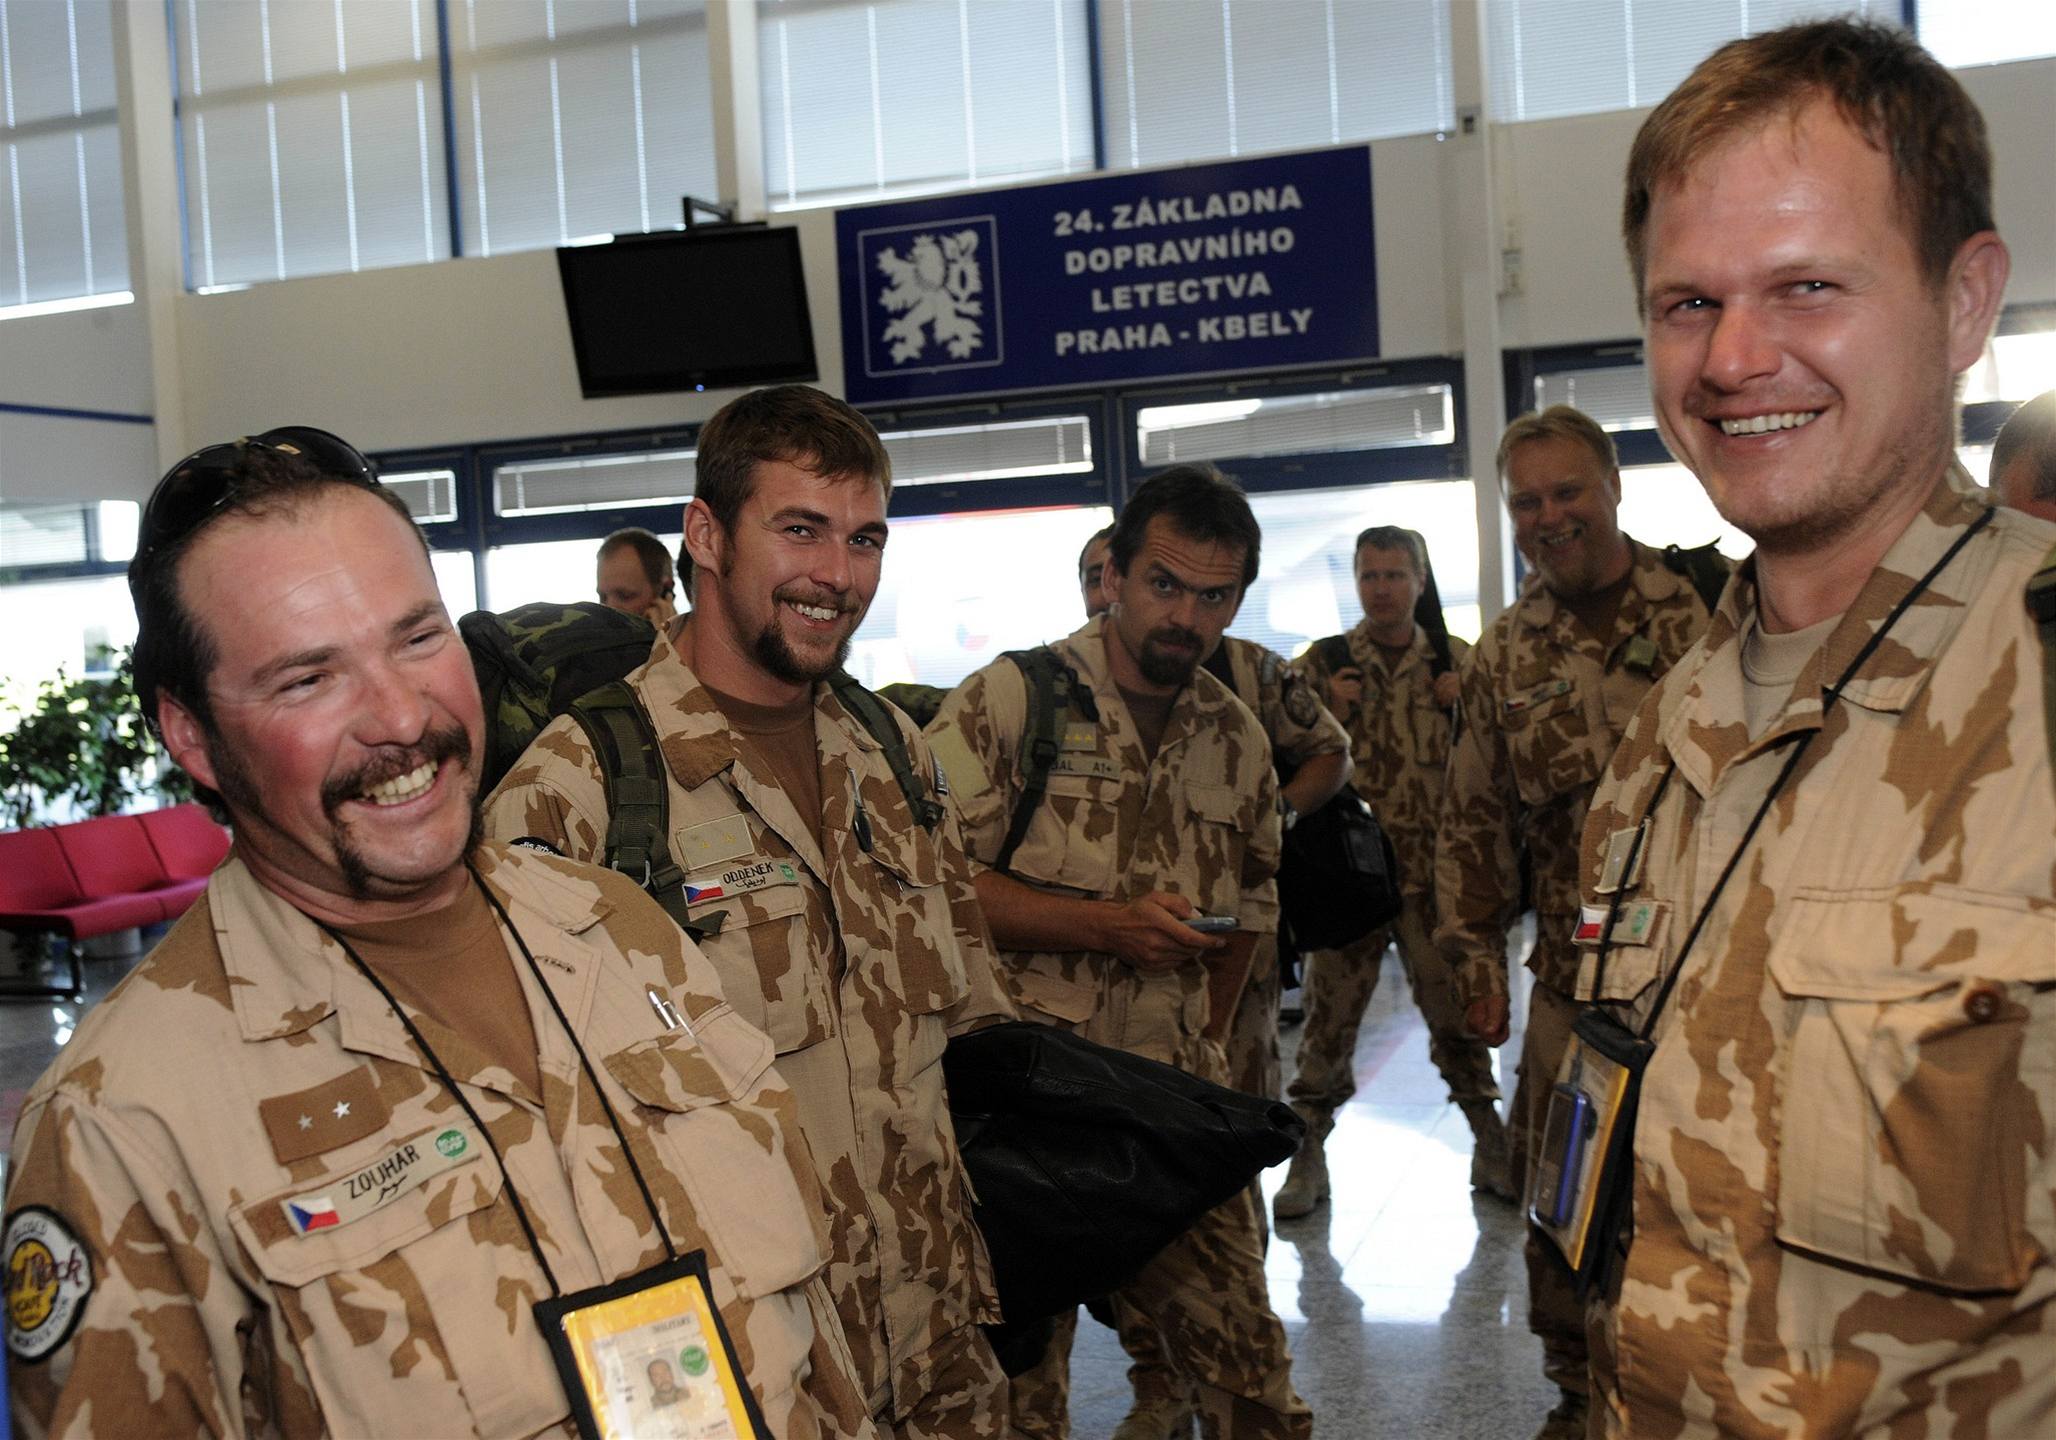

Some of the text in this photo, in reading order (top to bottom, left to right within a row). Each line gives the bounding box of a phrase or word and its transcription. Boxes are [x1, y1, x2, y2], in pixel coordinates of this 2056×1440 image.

[1054, 184, 1302, 236] 24. ZÁKLADNA
[1064, 226, 1295, 276] DOPRAVNÍHO
[1091, 271, 1272, 312] LETECTVA
[1055, 322, 1172, 356] PRAHA
[1198, 307, 1313, 343] KBELY
[722, 862, 774, 885] ODDENEK
[342, 1144, 420, 1199] ZOUHAR
